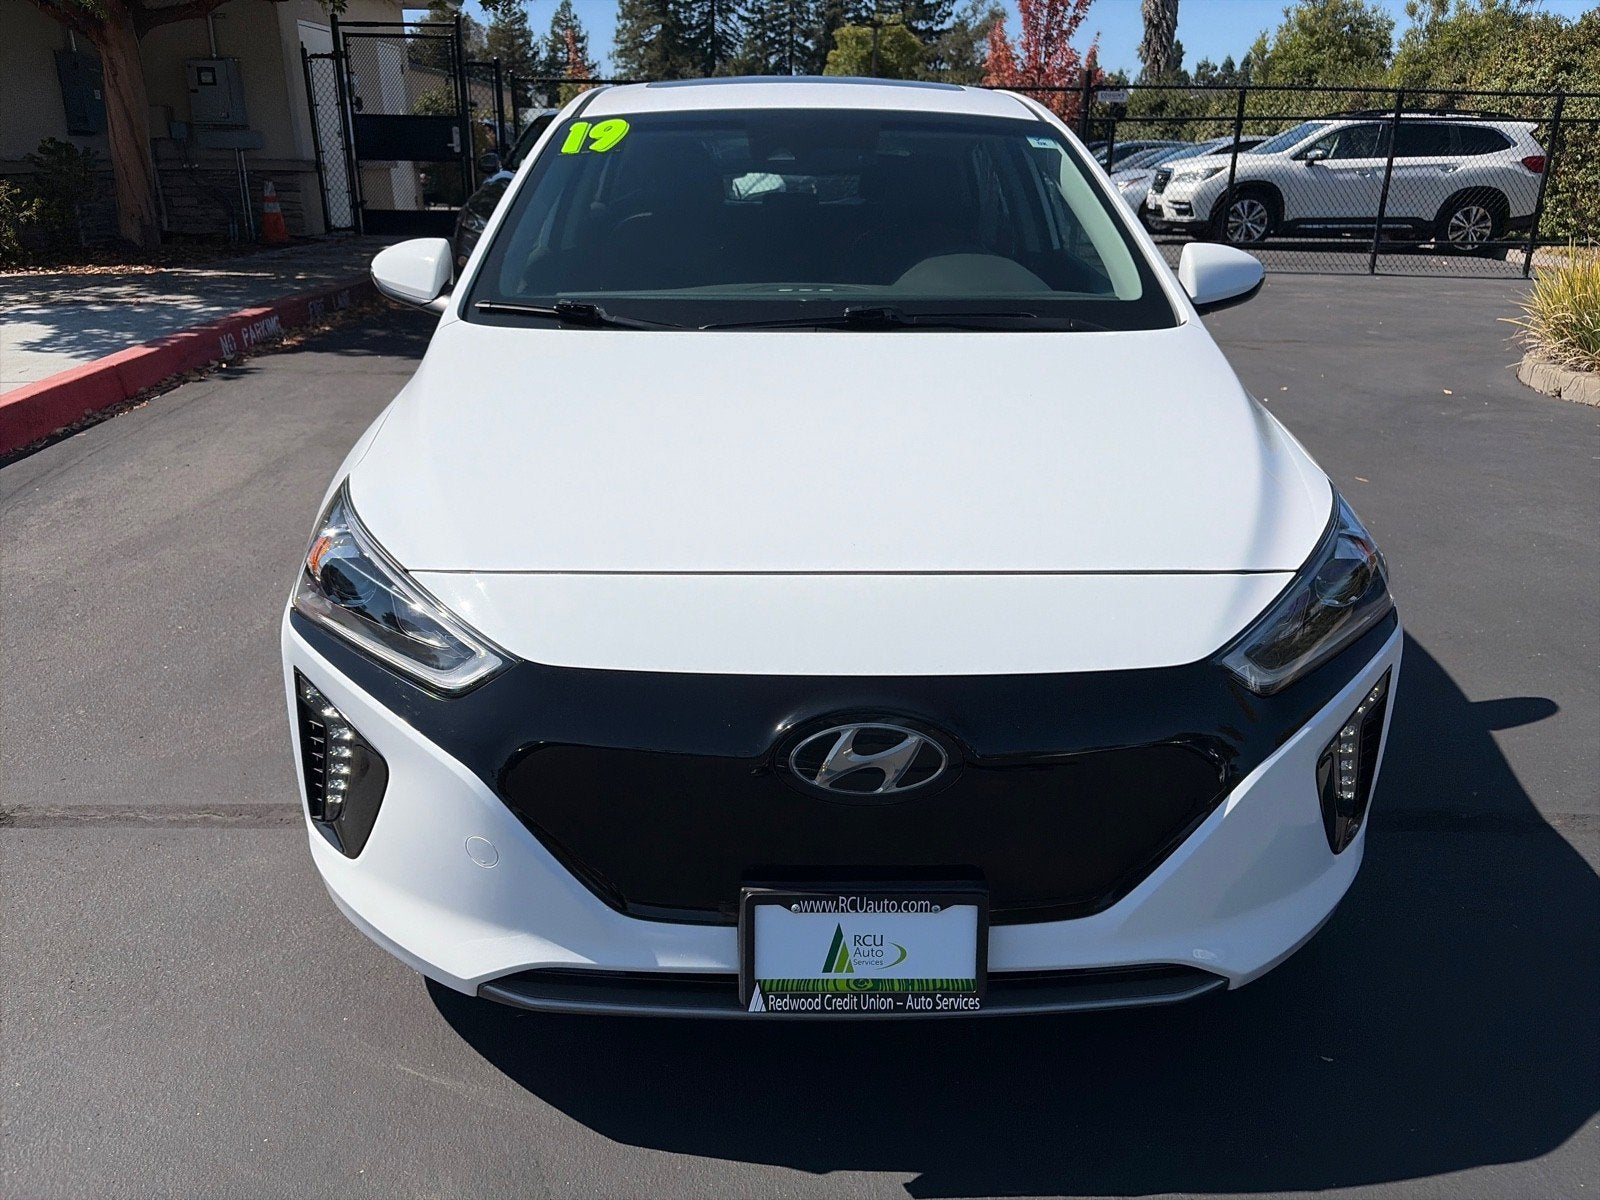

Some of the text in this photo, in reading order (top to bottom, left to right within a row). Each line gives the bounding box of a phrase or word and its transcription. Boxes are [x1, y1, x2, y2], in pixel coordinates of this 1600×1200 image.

[561, 118, 630, 154] 19
[219, 332, 237, 357] NO
[799, 896, 931, 913] www.RCUauto.com
[853, 934, 884, 946] RCU
[853, 947, 884, 958] Auto
[768, 994, 821, 1011] Redwood
[824, 994, 858, 1010] Credit
[860, 994, 894, 1010] Union
[906, 994, 933, 1010] Auto
[935, 994, 981, 1011] Services
